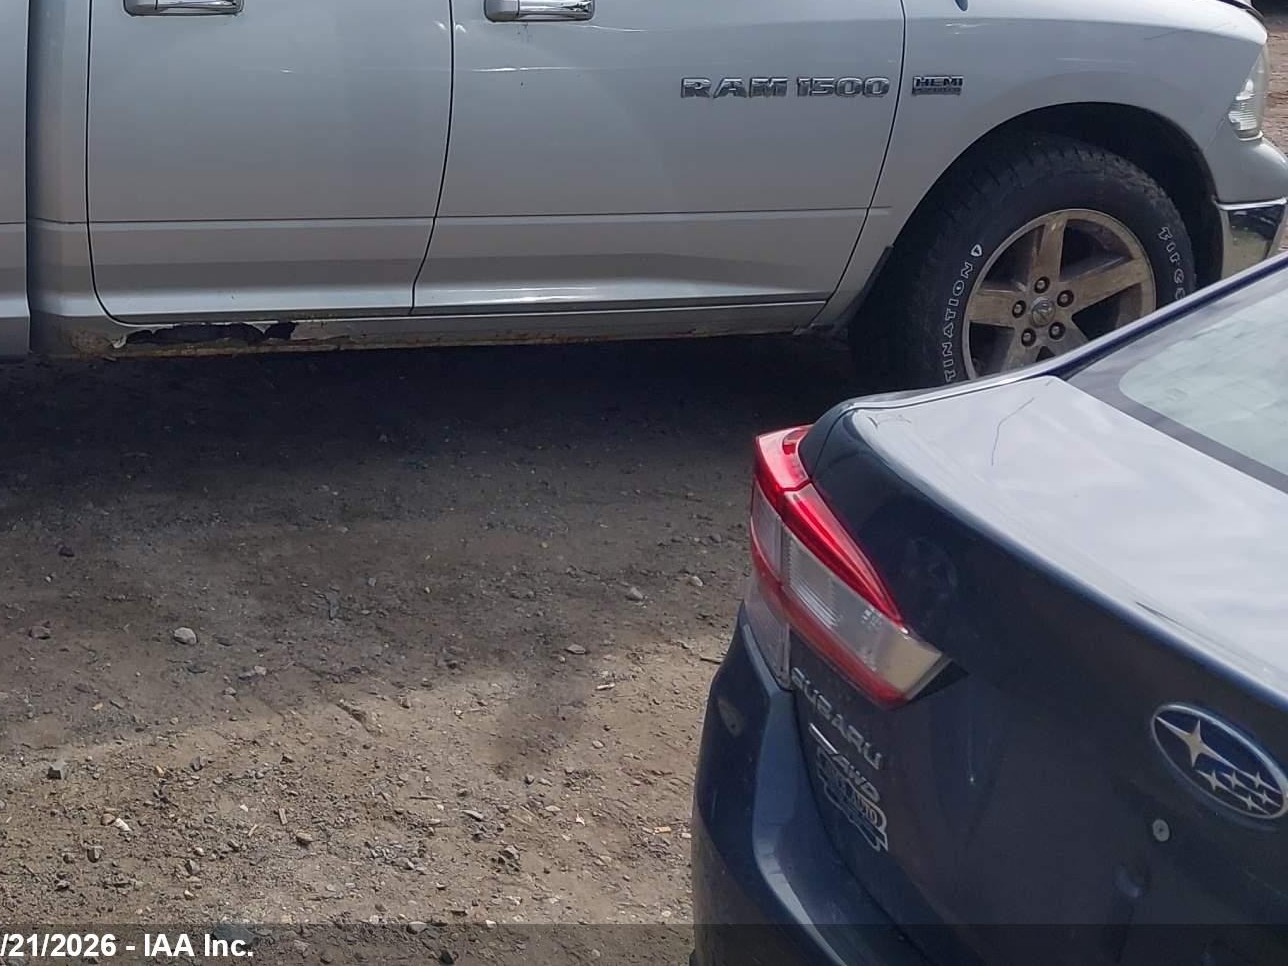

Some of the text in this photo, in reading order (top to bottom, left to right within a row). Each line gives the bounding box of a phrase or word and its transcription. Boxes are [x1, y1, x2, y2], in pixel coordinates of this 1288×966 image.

[680, 77, 891, 99] RAM 1500
[912, 75, 964, 89] HEMI
[942, 261, 974, 383] TINATION
[791, 667, 882, 769] SUBARU
